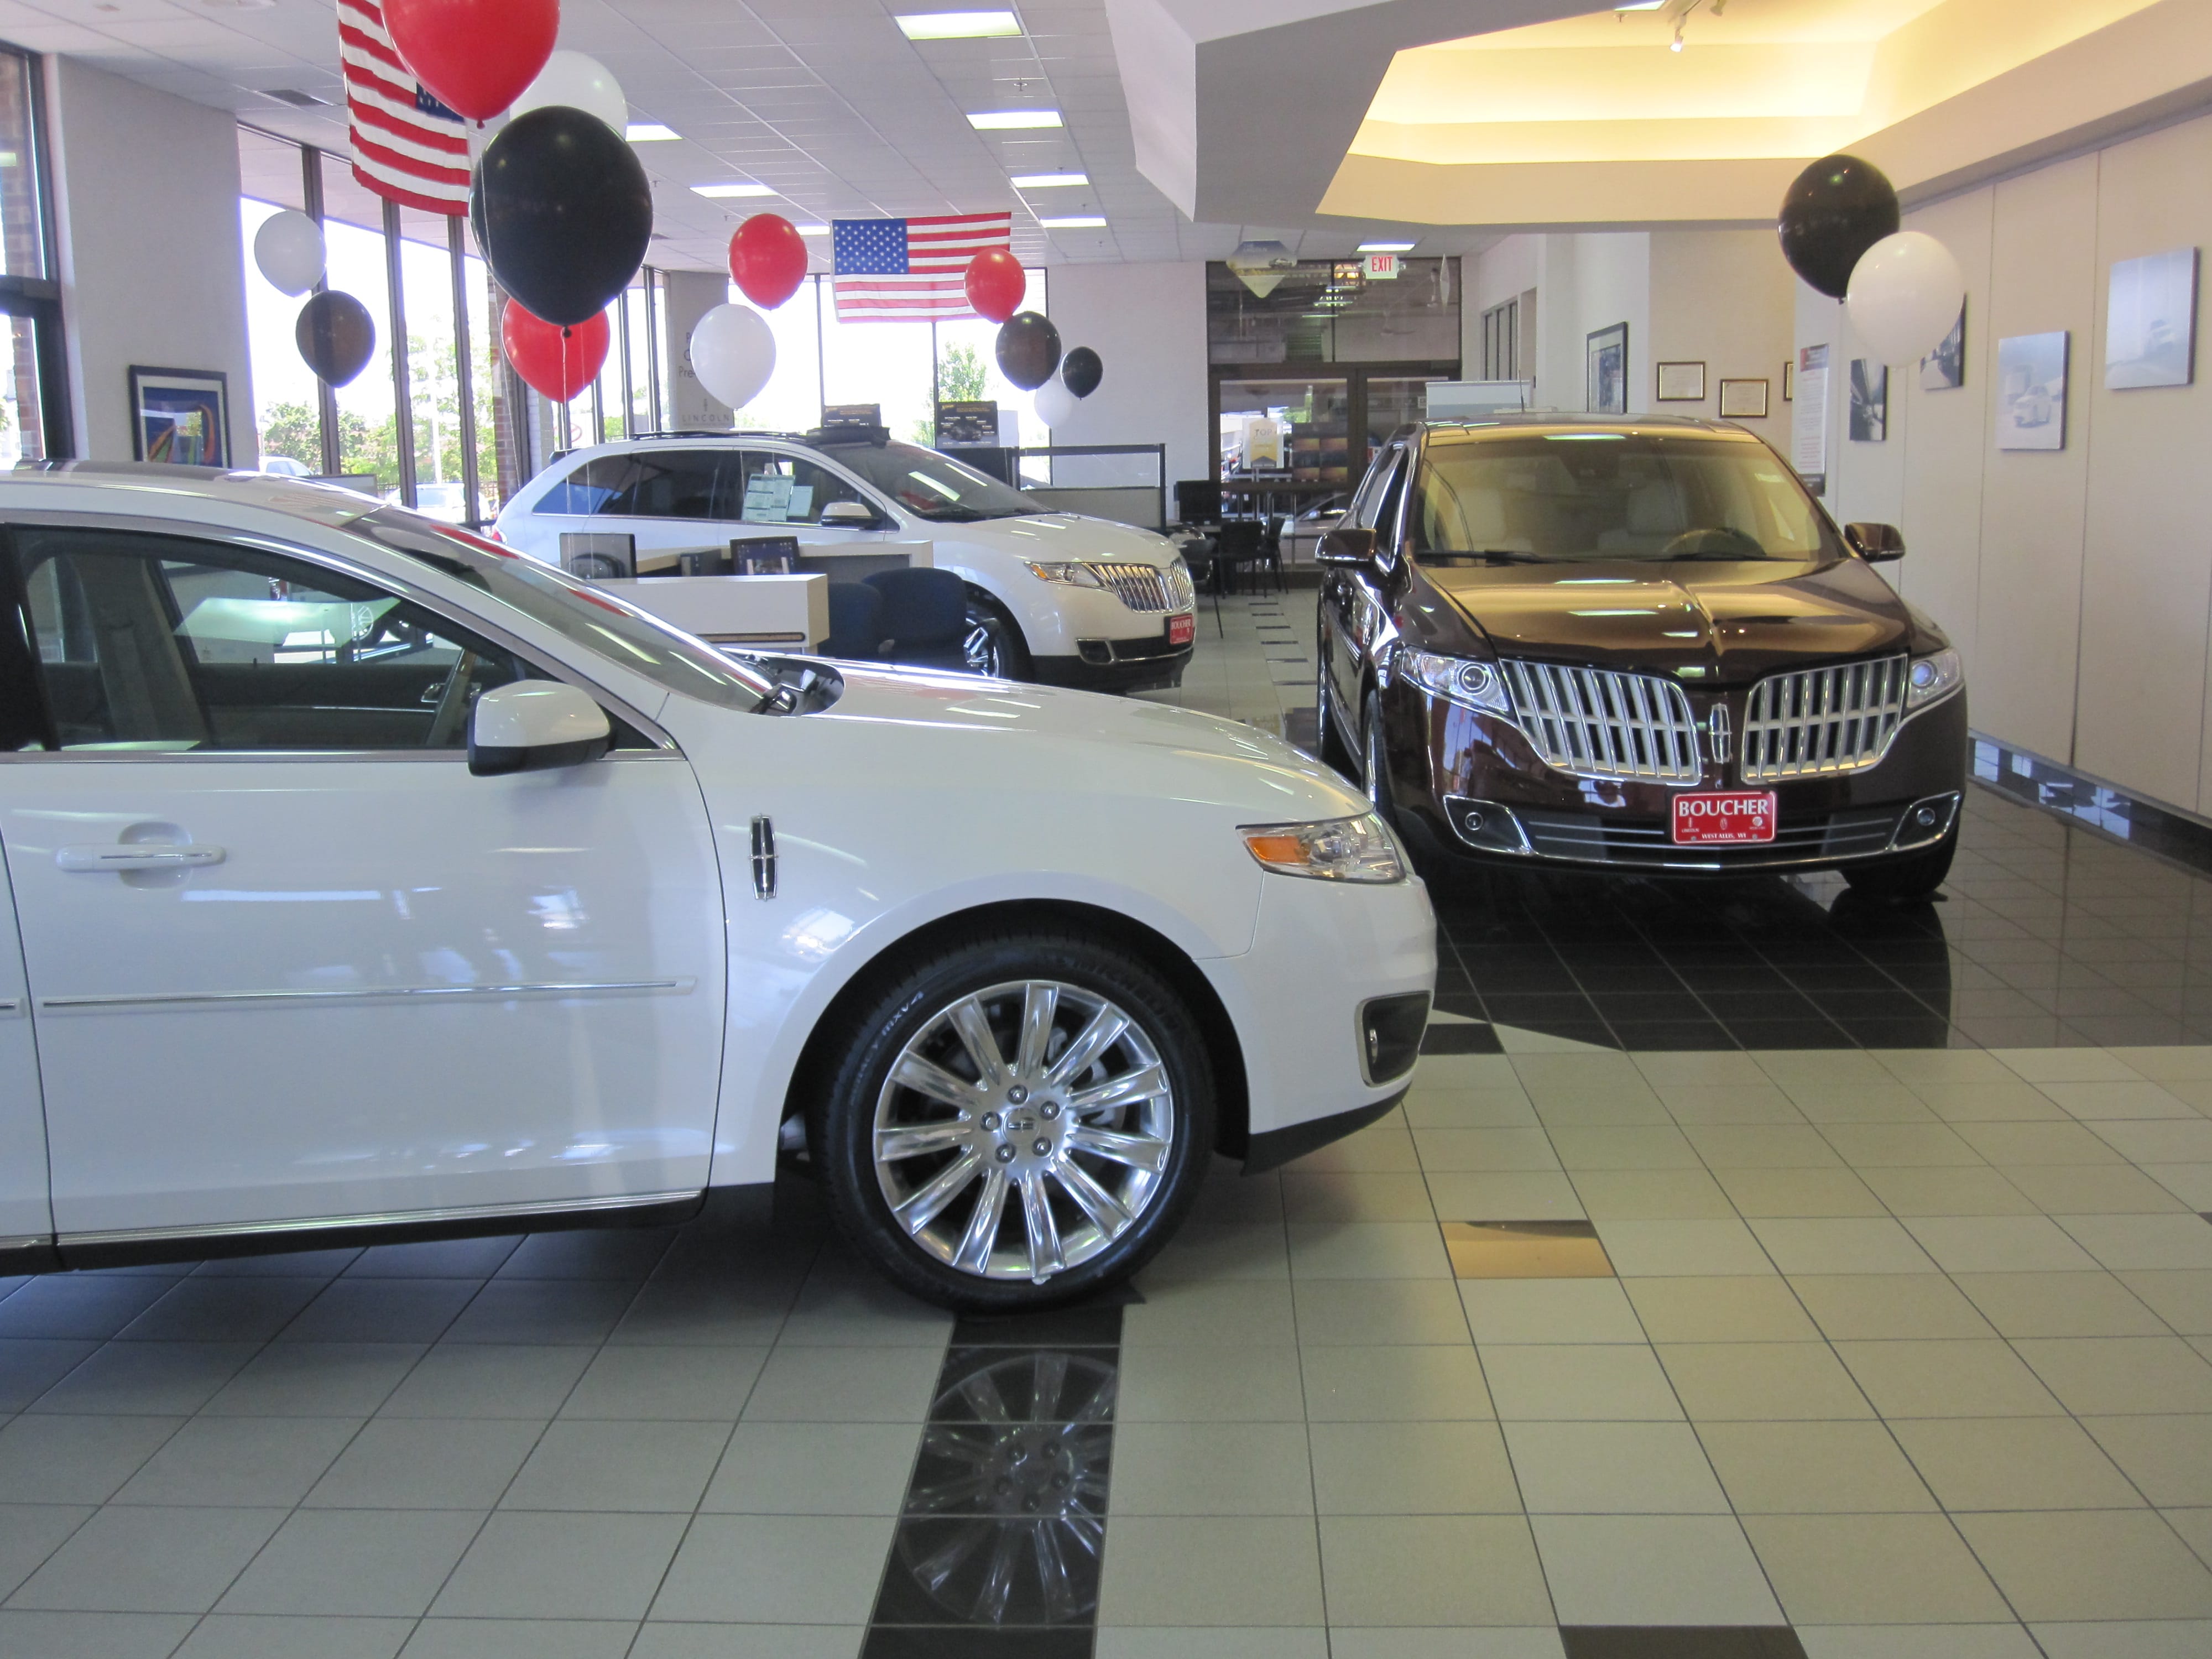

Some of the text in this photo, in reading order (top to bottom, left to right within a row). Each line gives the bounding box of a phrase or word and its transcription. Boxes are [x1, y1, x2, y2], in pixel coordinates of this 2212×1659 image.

[1371, 256, 1393, 272] EXIT
[682, 414, 730, 422] LINCOLN
[1171, 619, 1191, 630] BOUCHER
[1679, 799, 1769, 817] BOUCHER
